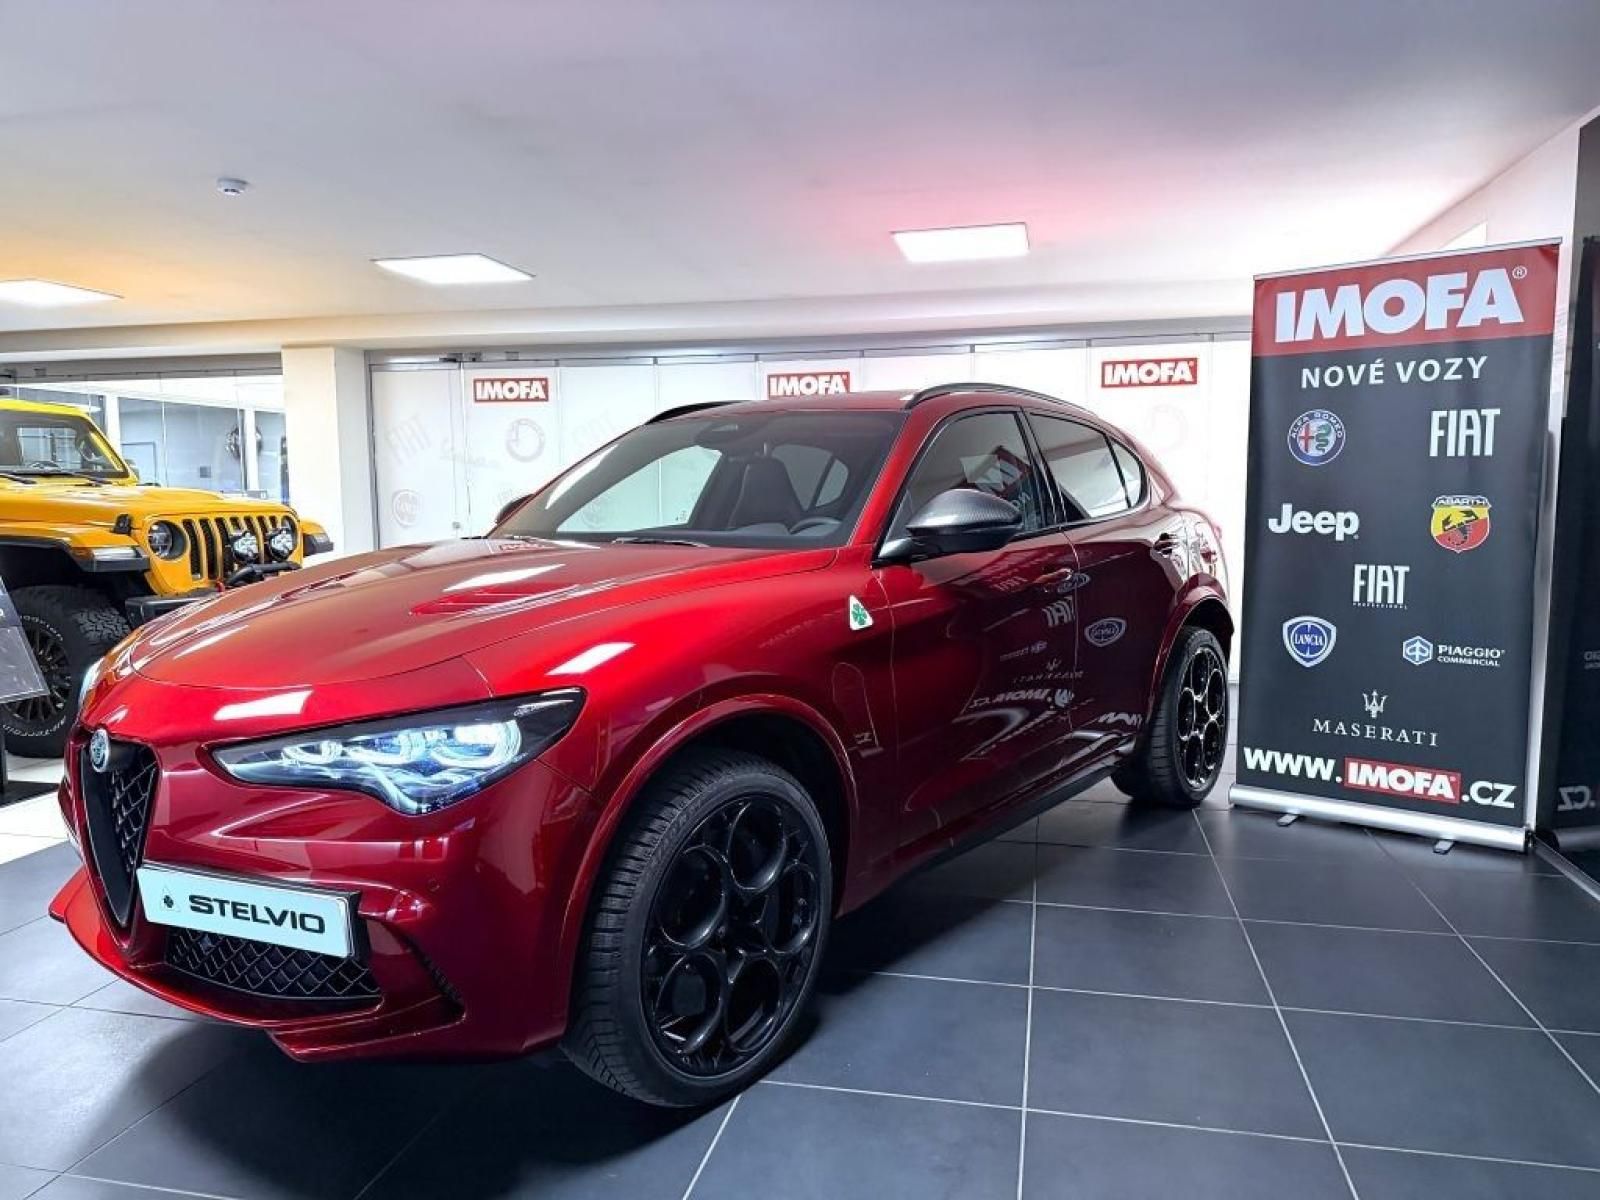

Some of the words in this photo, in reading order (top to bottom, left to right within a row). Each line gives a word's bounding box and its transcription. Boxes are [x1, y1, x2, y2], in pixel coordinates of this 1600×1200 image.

[769, 374, 849, 396] IMOFA
[1103, 361, 1194, 385] IMOFA
[1301, 358, 1385, 388] NOVÉ
[1395, 355, 1488, 384] VOZY
[475, 380, 546, 400] IMOFA
[1429, 408, 1500, 457] FIAT
[1268, 503, 1359, 541] Jeep
[1352, 563, 1410, 604] FIAT
[1294, 633, 1324, 647] LANCIA
[1437, 655, 1501, 667] COMMERCIAL
[1312, 718, 1439, 747] MASERATI
[188, 894, 326, 934] STELVIO
